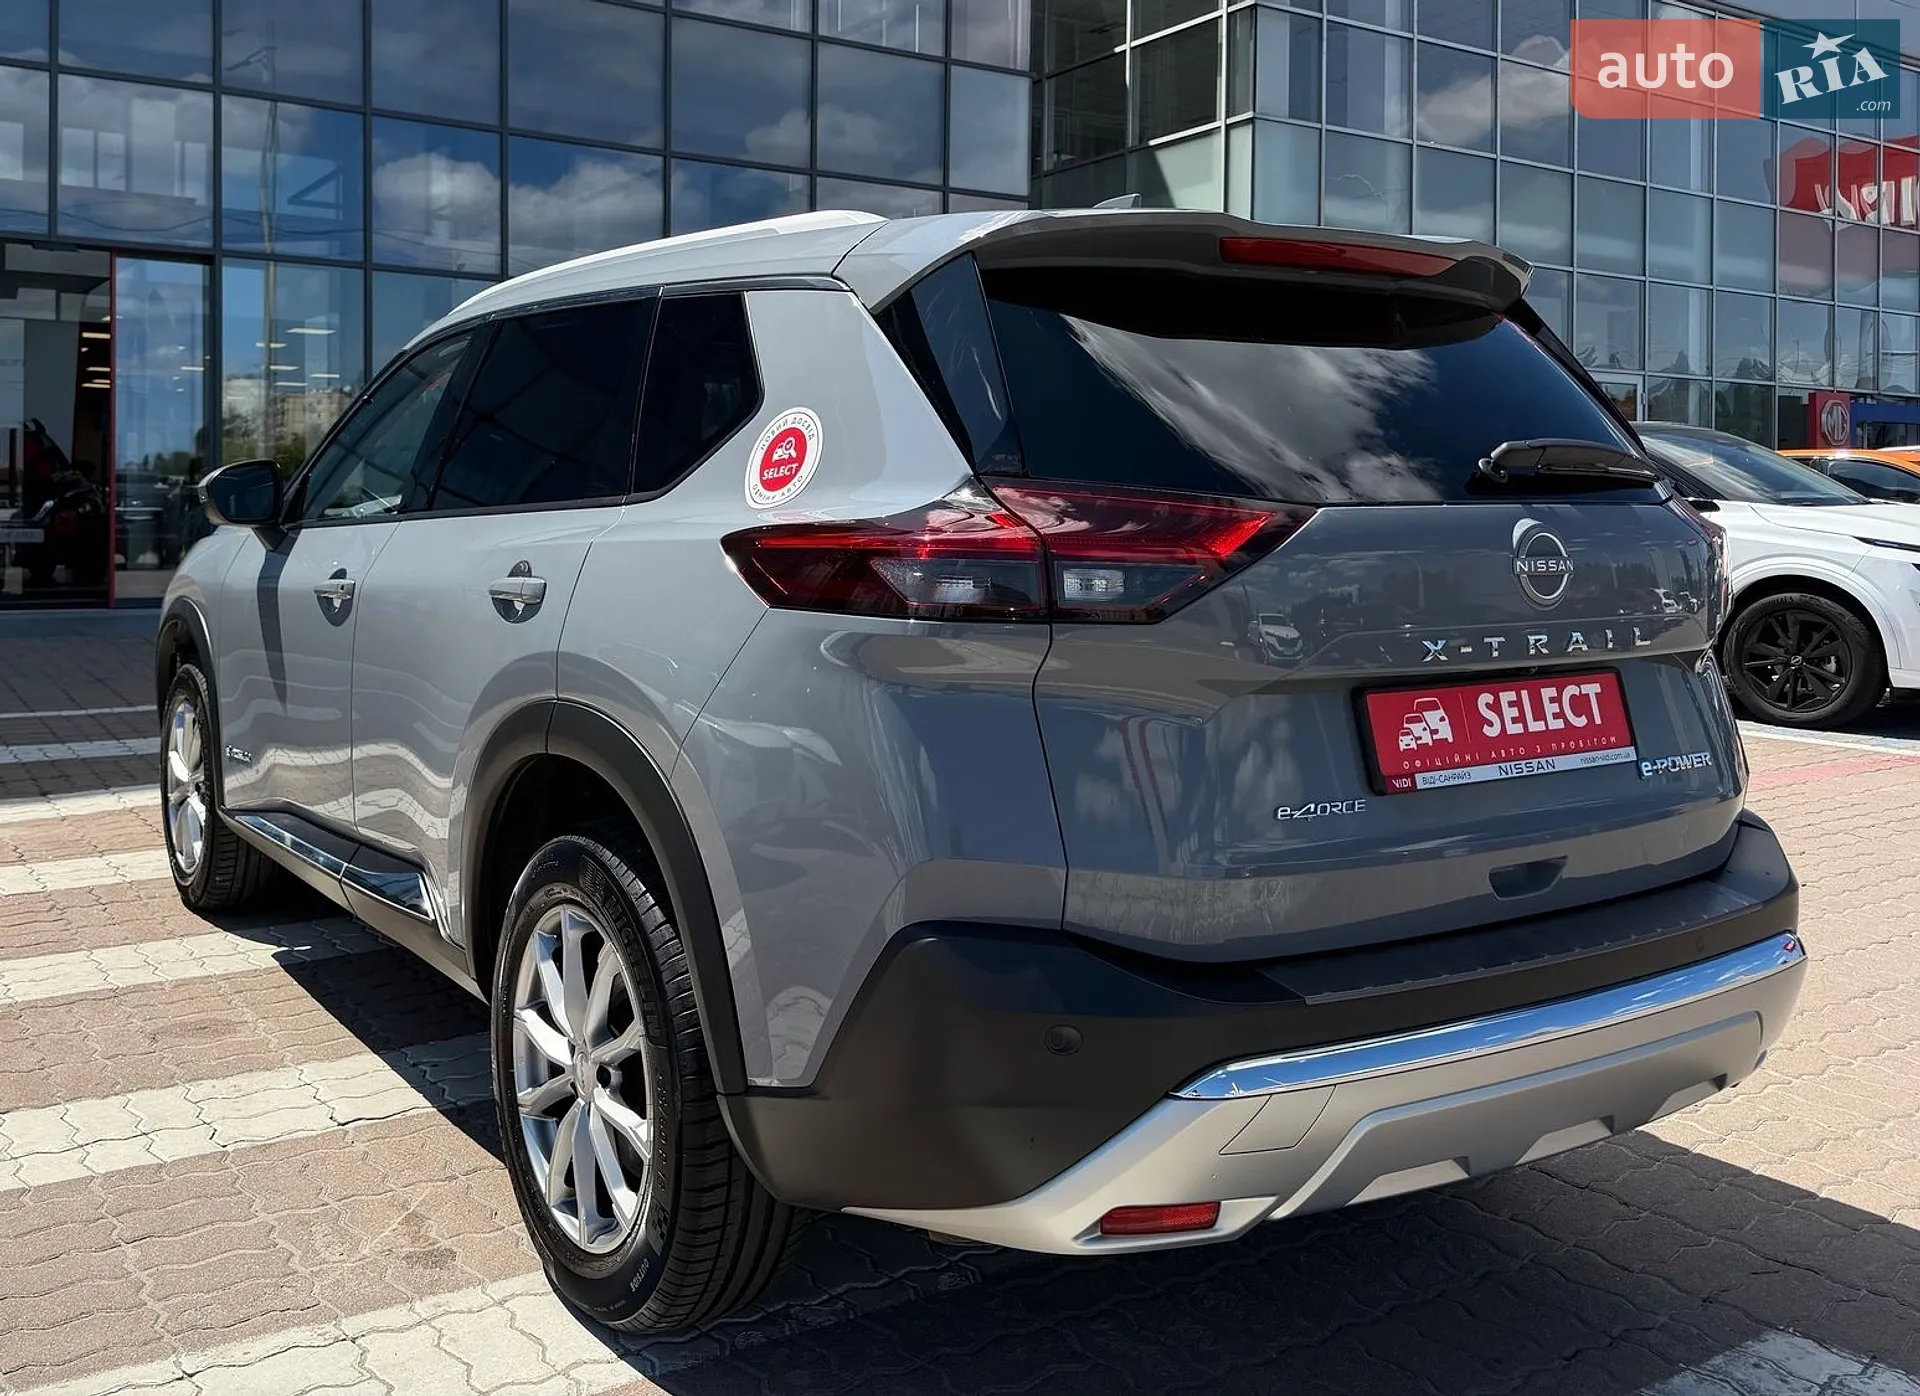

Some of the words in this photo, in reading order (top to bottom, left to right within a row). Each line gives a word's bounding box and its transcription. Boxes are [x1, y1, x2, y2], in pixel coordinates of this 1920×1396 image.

[1828, 406, 1849, 441] MG
[762, 463, 799, 480] SELECT
[1516, 558, 1574, 573] NISSAN
[1421, 626, 1652, 663] X-TRAIL
[1476, 682, 1602, 738] SELECT
[1490, 746, 1527, 760] АВТО
[1551, 735, 1618, 752] ПРОБІГОМ
[1499, 758, 1557, 777] NISSAN
[1640, 751, 1713, 778] e-POWER
[1391, 777, 1413, 789] VIDI
